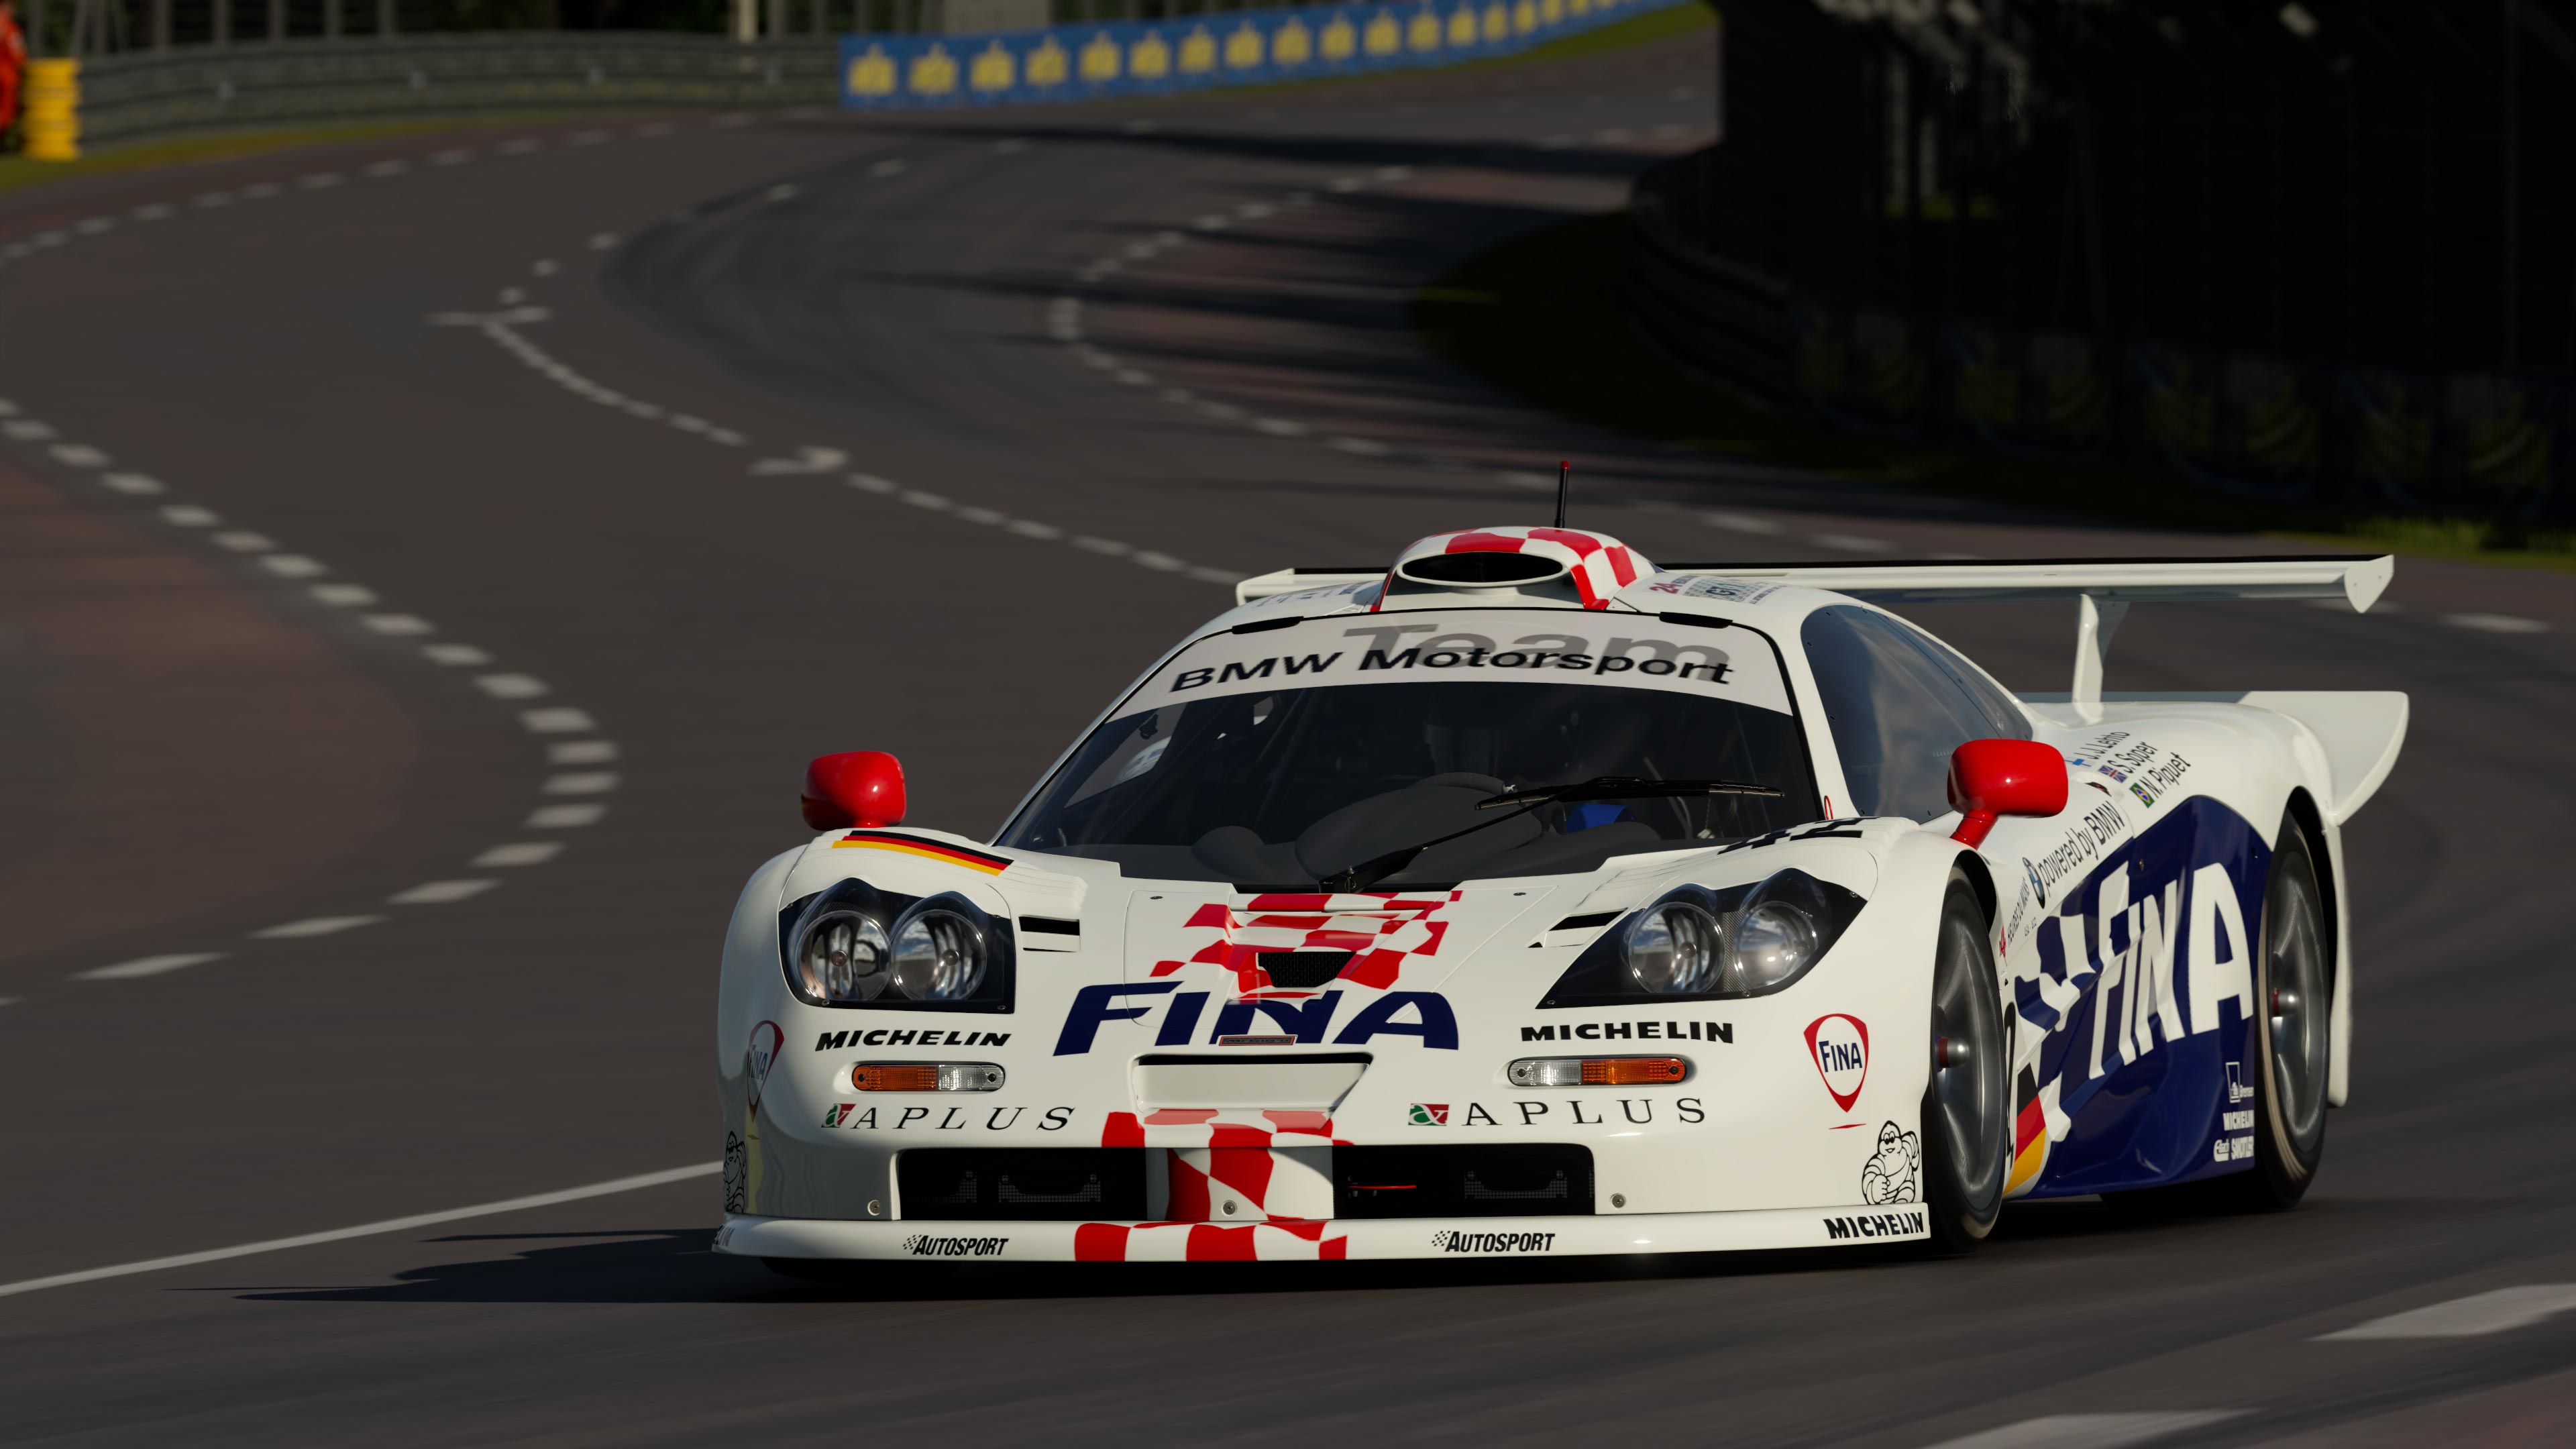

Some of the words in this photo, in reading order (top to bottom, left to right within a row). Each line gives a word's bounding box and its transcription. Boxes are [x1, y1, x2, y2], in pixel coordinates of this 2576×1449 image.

[1344, 624, 1730, 680] Team
[1169, 651, 1345, 693] BMW
[1359, 647, 1735, 685] Motorsport
[2037, 831, 2084, 898] powered
[2070, 827, 2098, 861] by
[2084, 800, 2125, 845] BMW
[2088, 861, 2254, 1080] FINA
[1052, 981, 1459, 1057] FINA
[1521, 1022, 1733, 1044] MICHELIN
[815, 1030, 1011, 1051] MICHELIN
[748, 1044, 768, 1081] FINA
[1818, 1040, 1863, 1073] FINA
[850, 1106, 1076, 1130] APLUS
[1461, 1097, 1705, 1126] APLUS
[2222, 1110, 2255, 1131] MICHELIN
[1823, 1212, 1925, 1239] MICHELIN
[912, 1235, 1009, 1256] AUTOSPORT
[1445, 1231, 1556, 1252] AUTOSPORT
